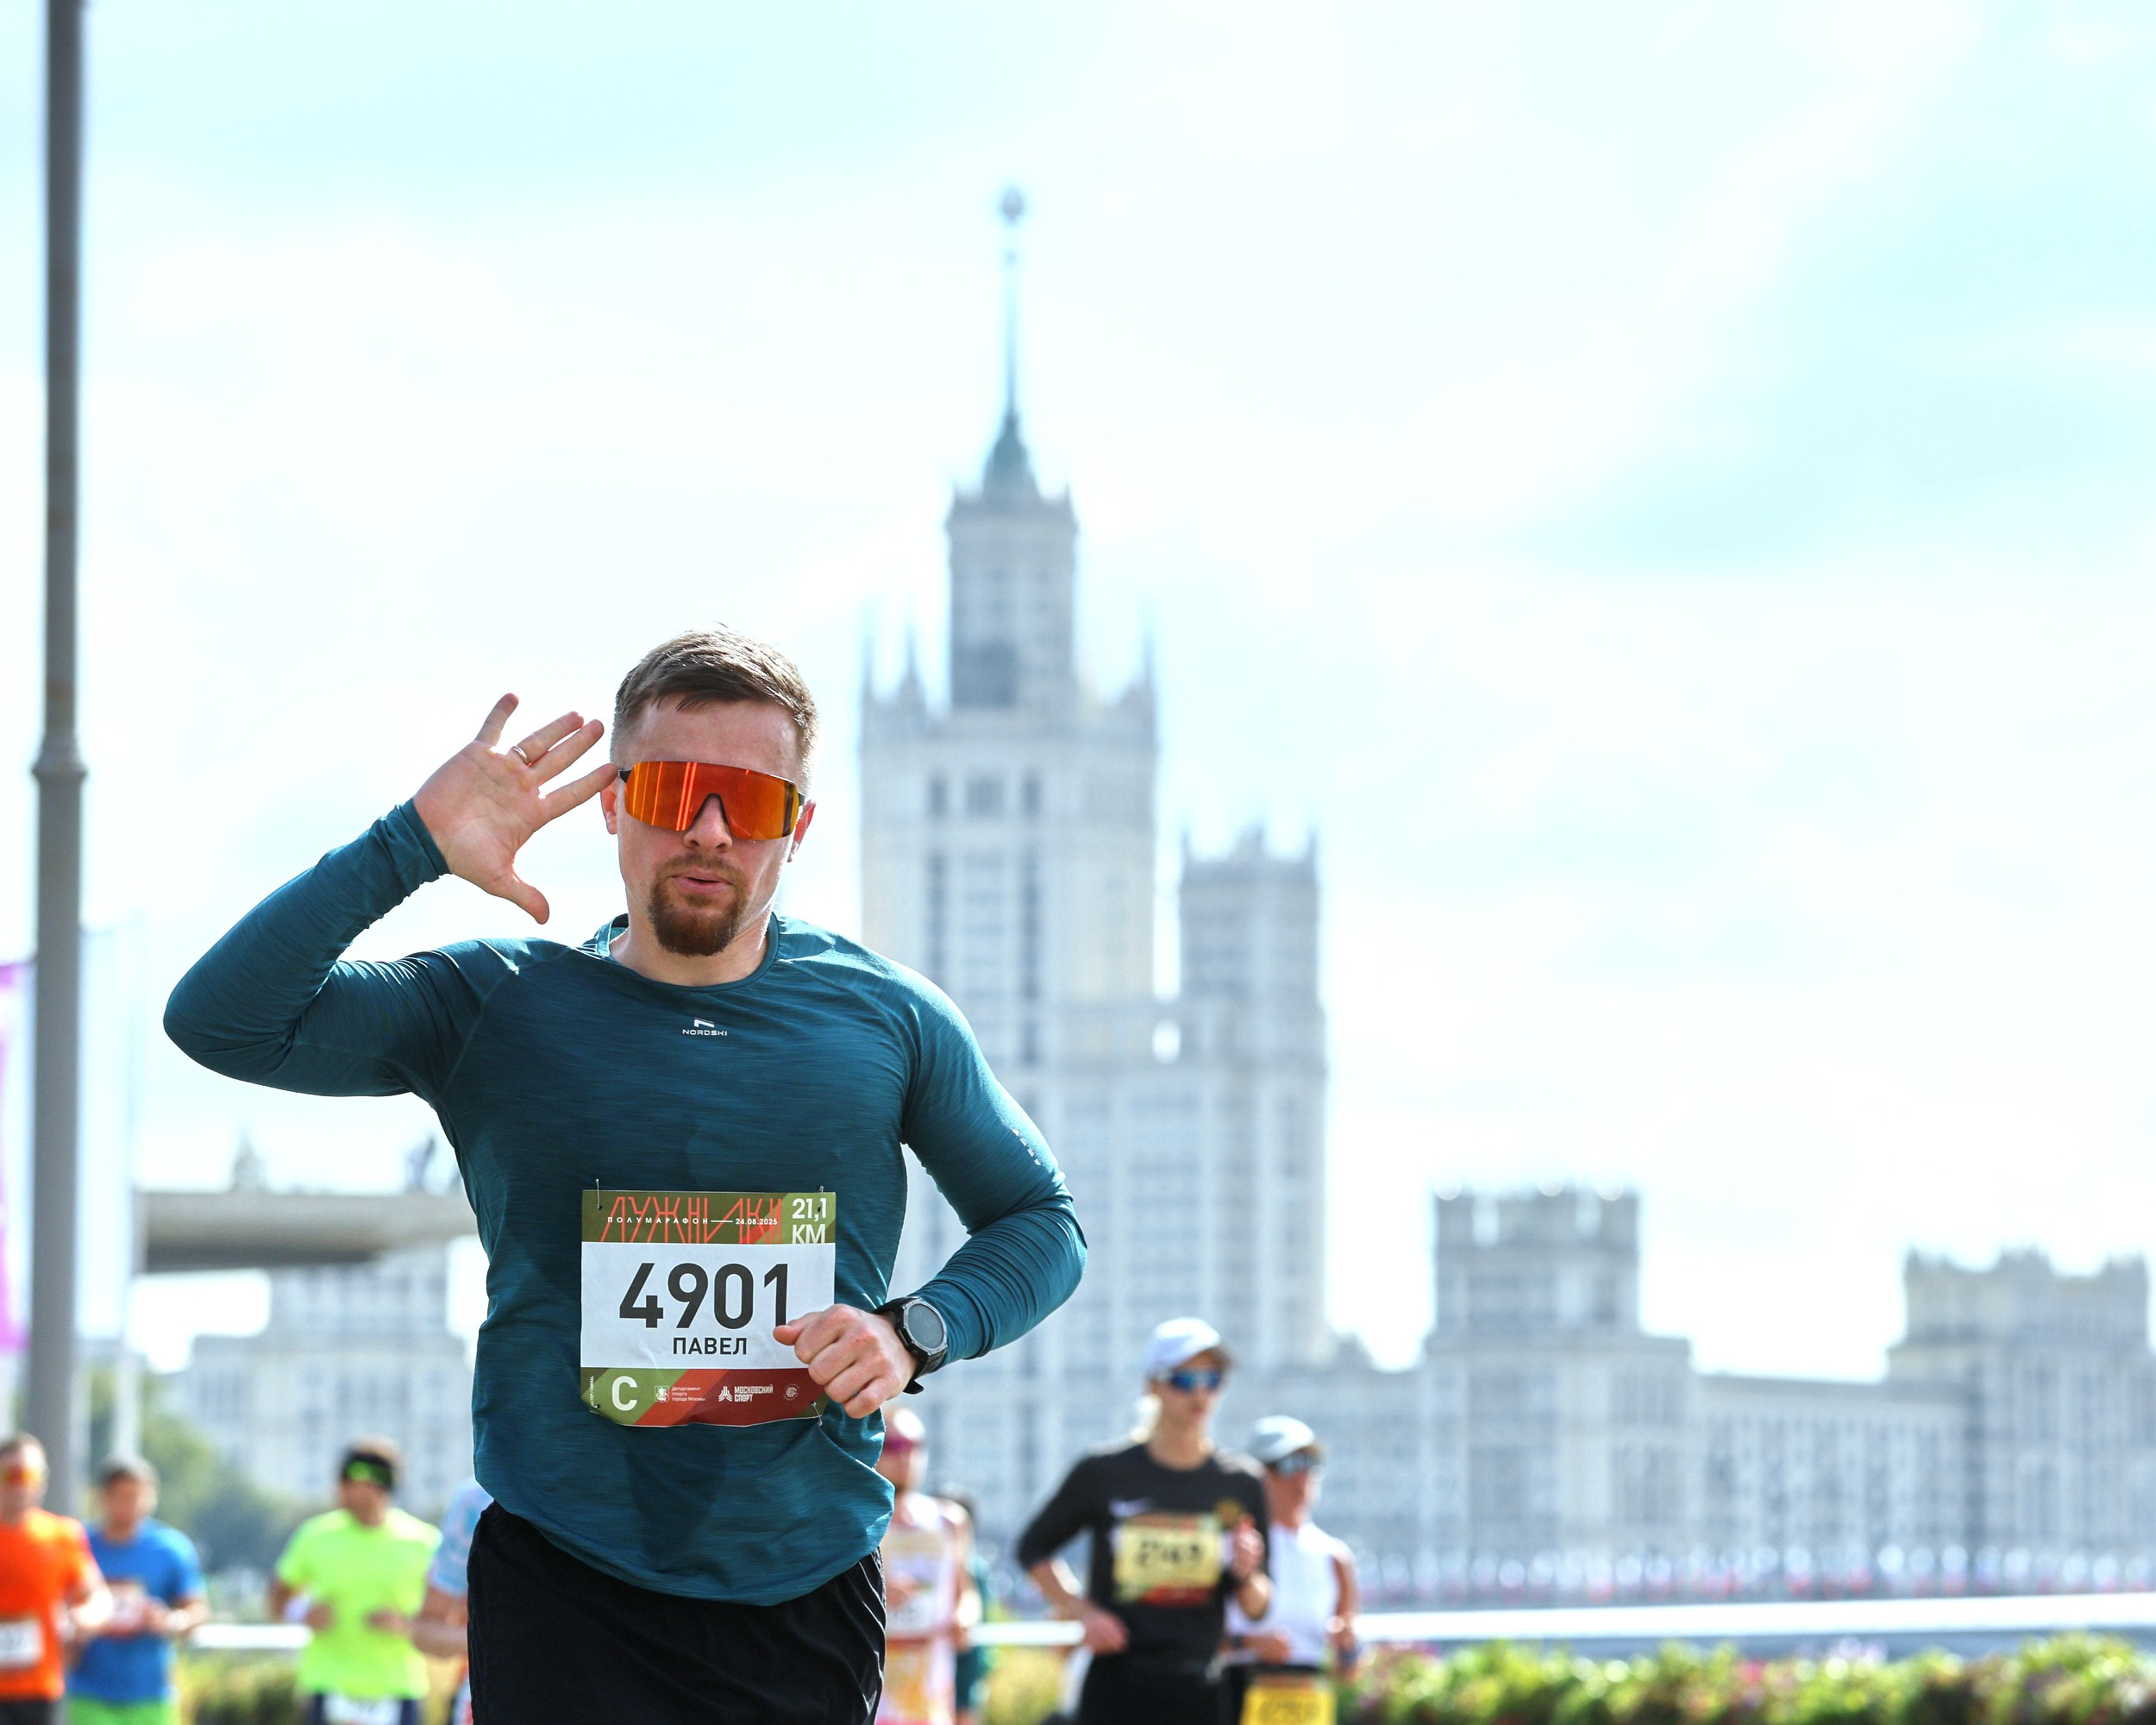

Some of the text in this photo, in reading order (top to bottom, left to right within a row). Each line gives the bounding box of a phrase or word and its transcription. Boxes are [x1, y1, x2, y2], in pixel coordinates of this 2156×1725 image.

[793, 1198, 826, 1221] 21,1
[600, 1196, 781, 1244] ЛУЖНИКИ
[607, 1216, 708, 1225] ПОЛУМАРАФОН
[619, 1263, 788, 1329] 4901
[673, 1337, 748, 1355] ПАВЕЛ
[734, 1384, 774, 1394] МОСКОВСКИЙ
[734, 1394, 753, 1402] СПОРТ
